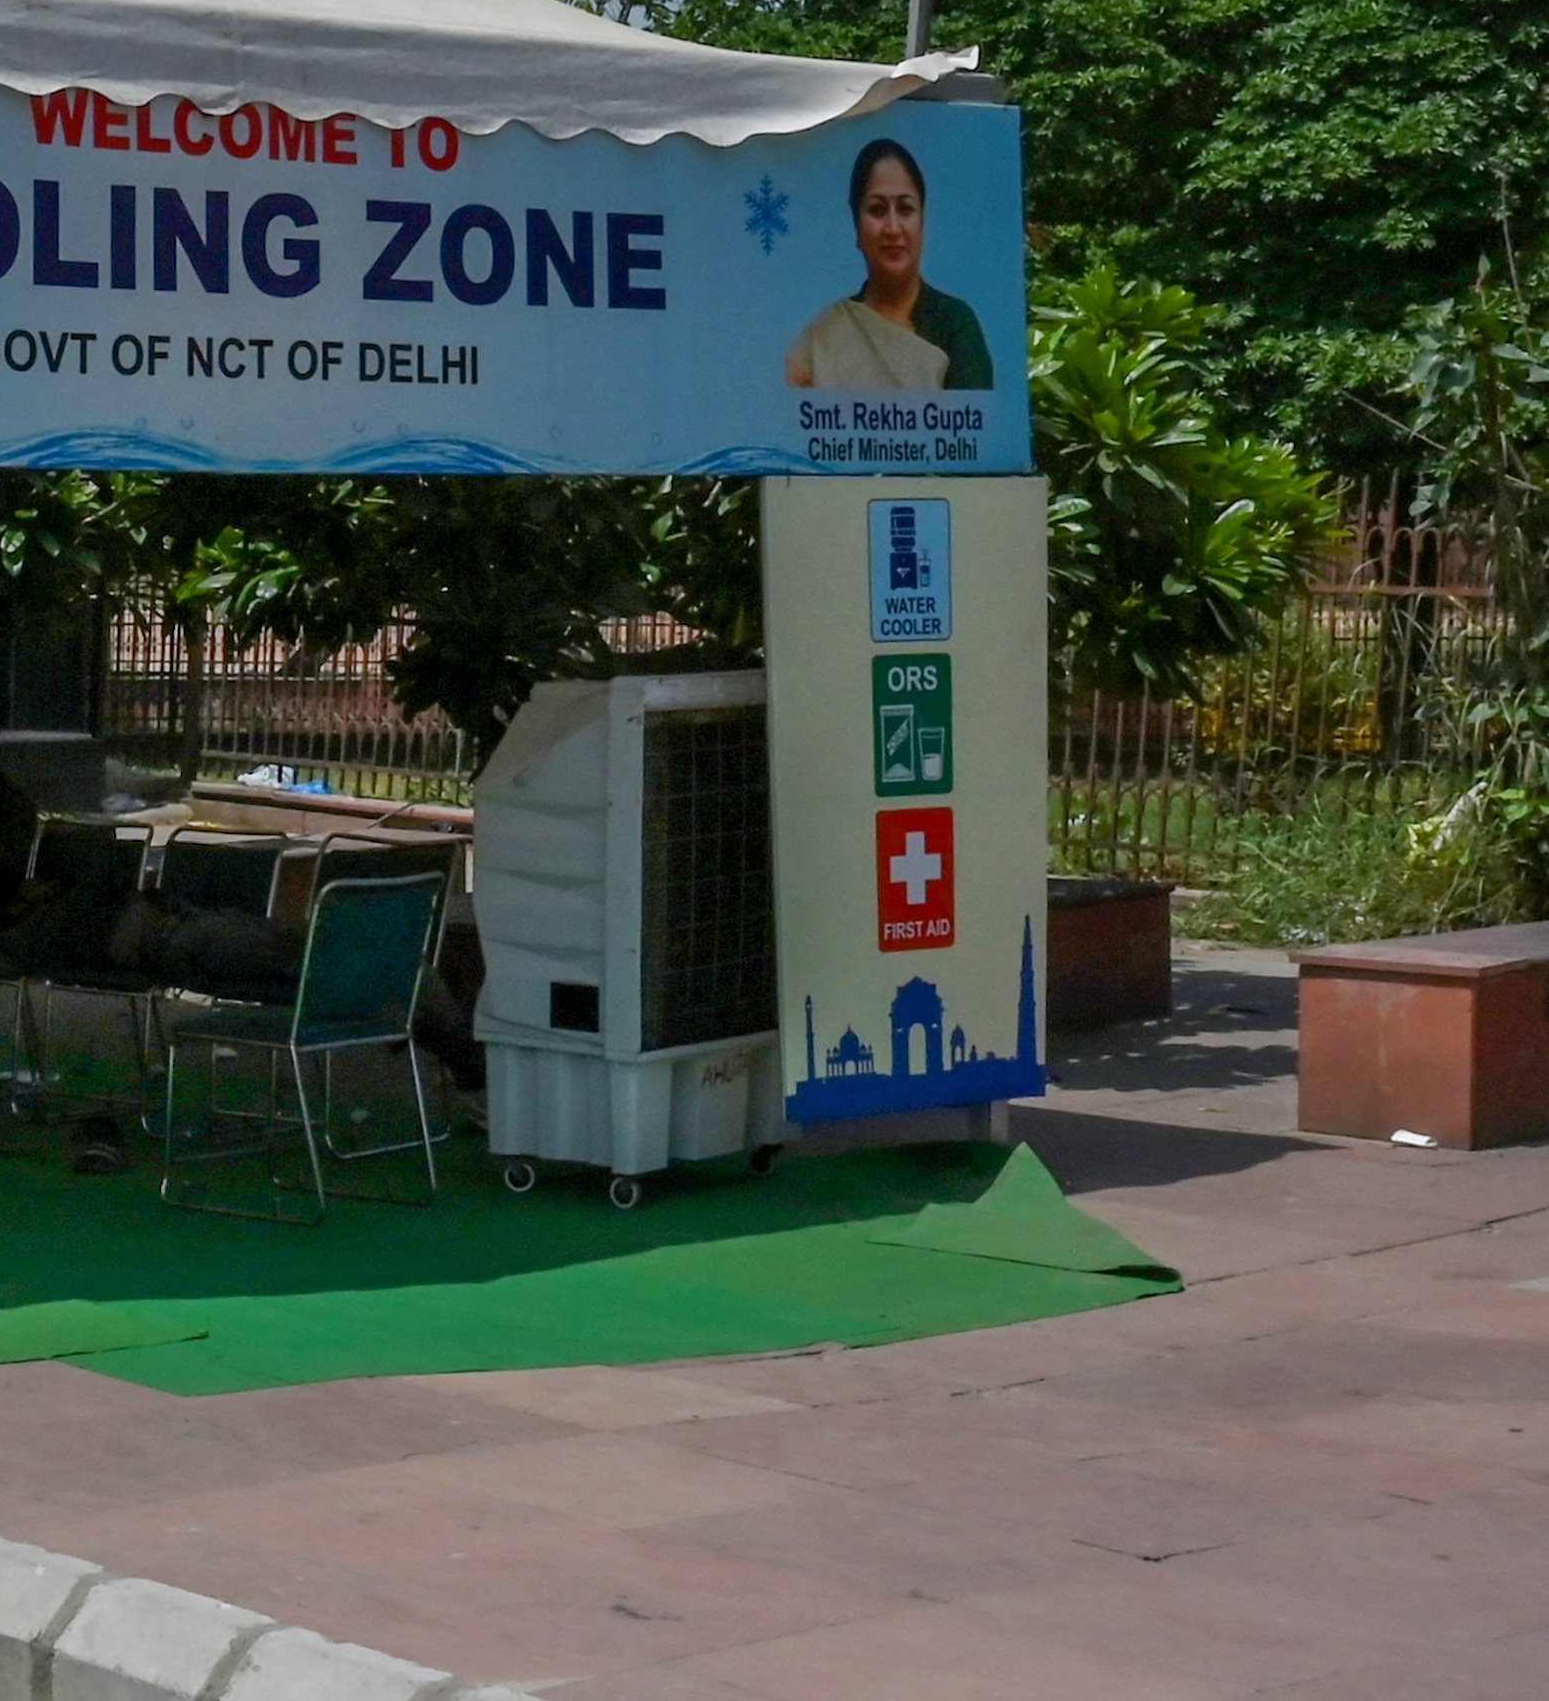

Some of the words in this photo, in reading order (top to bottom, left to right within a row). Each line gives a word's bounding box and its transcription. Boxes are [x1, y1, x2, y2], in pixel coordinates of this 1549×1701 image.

[30, 88, 357, 165] WELCOME
[363, 199, 666, 310] ZONE
[112, 334, 170, 376] OF
[187, 337, 274, 379] NCT
[287, 340, 343, 381] OF
[359, 343, 478, 385] DELHI
[800, 401, 846, 430] Smt.
[853, 402, 916, 430] Rekha
[923, 403, 982, 437] Gupta
[808, 437, 853, 461] Chief
[858, 437, 930, 464] Minister,
[935, 437, 977, 461] Delhi
[885, 597, 936, 614] WATER
[881, 618, 941, 636] COOLER
[887, 665, 938, 692] ORS
[884, 921, 923, 941] FIRST
[926, 919, 951, 937] AID
